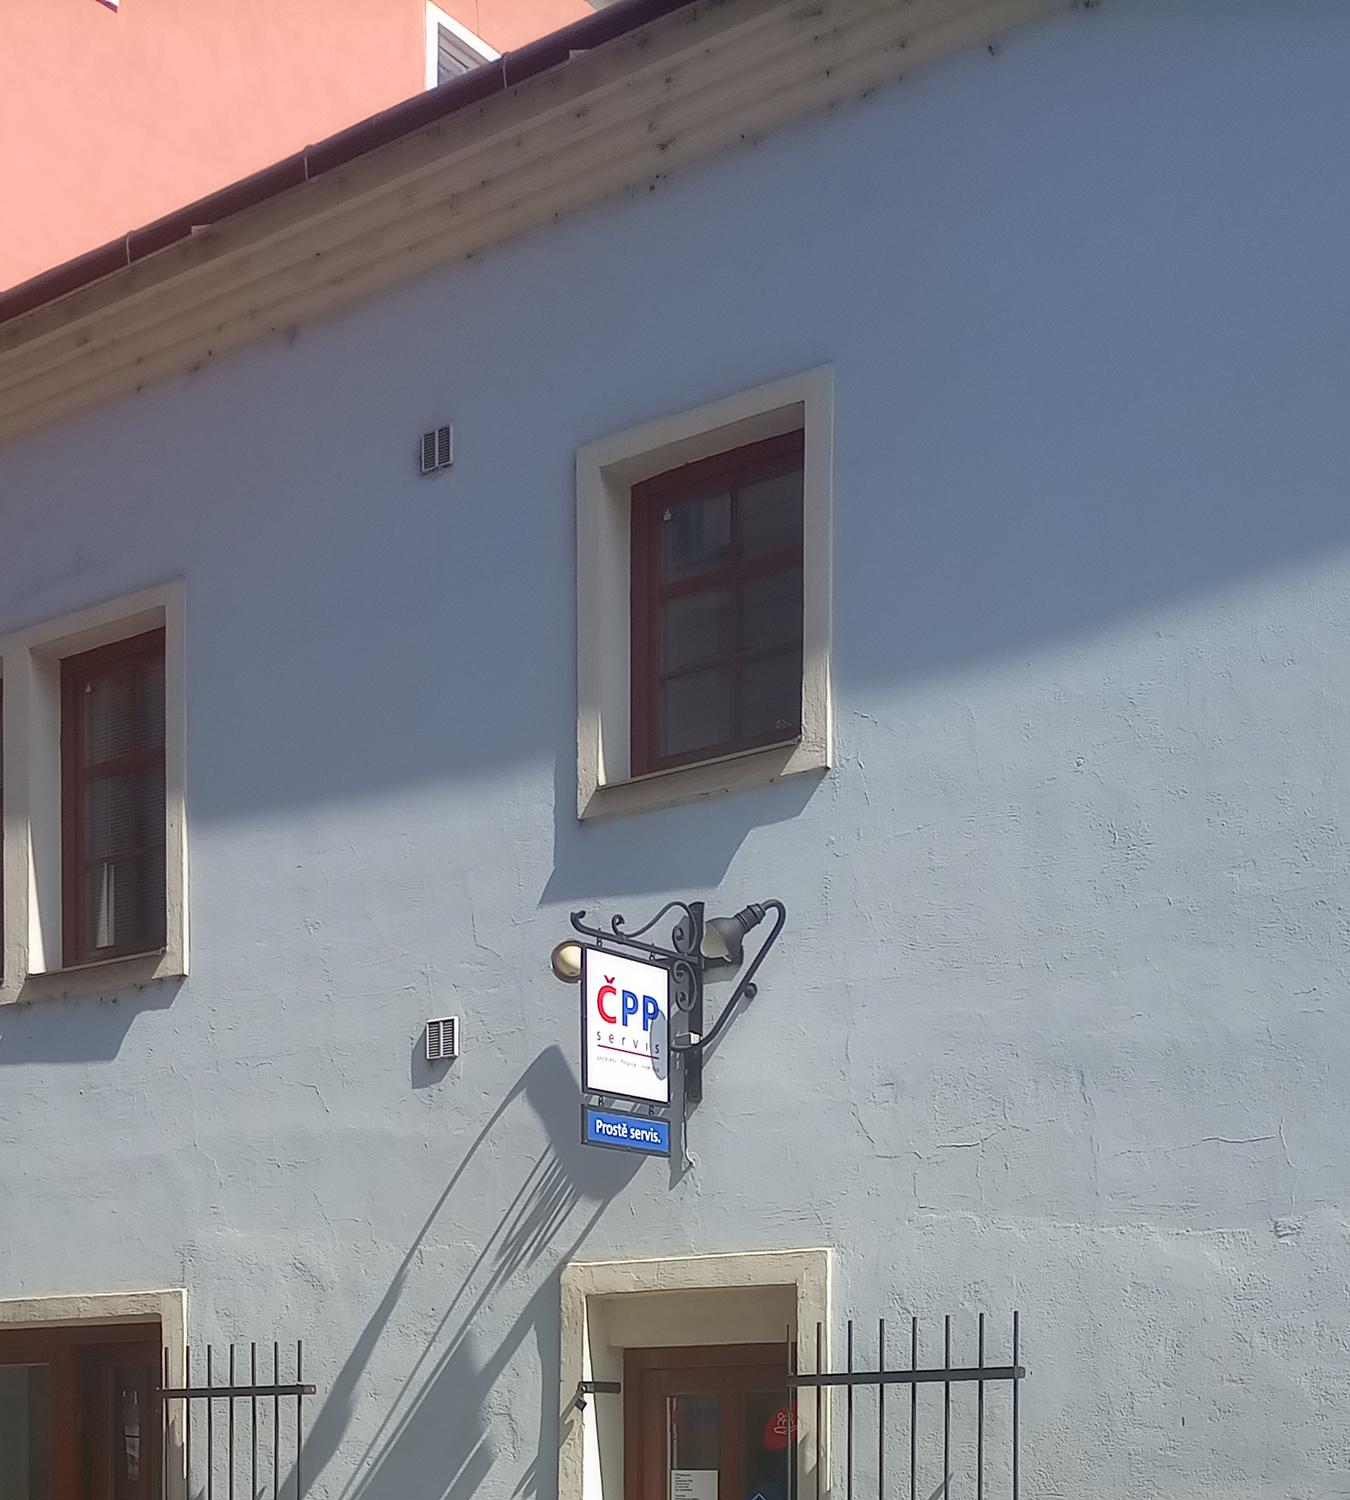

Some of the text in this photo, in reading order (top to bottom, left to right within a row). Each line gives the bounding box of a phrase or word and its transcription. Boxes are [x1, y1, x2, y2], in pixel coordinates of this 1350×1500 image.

[596, 975, 660, 1031] ČPP
[595, 1119, 662, 1143] Prostě servis.
